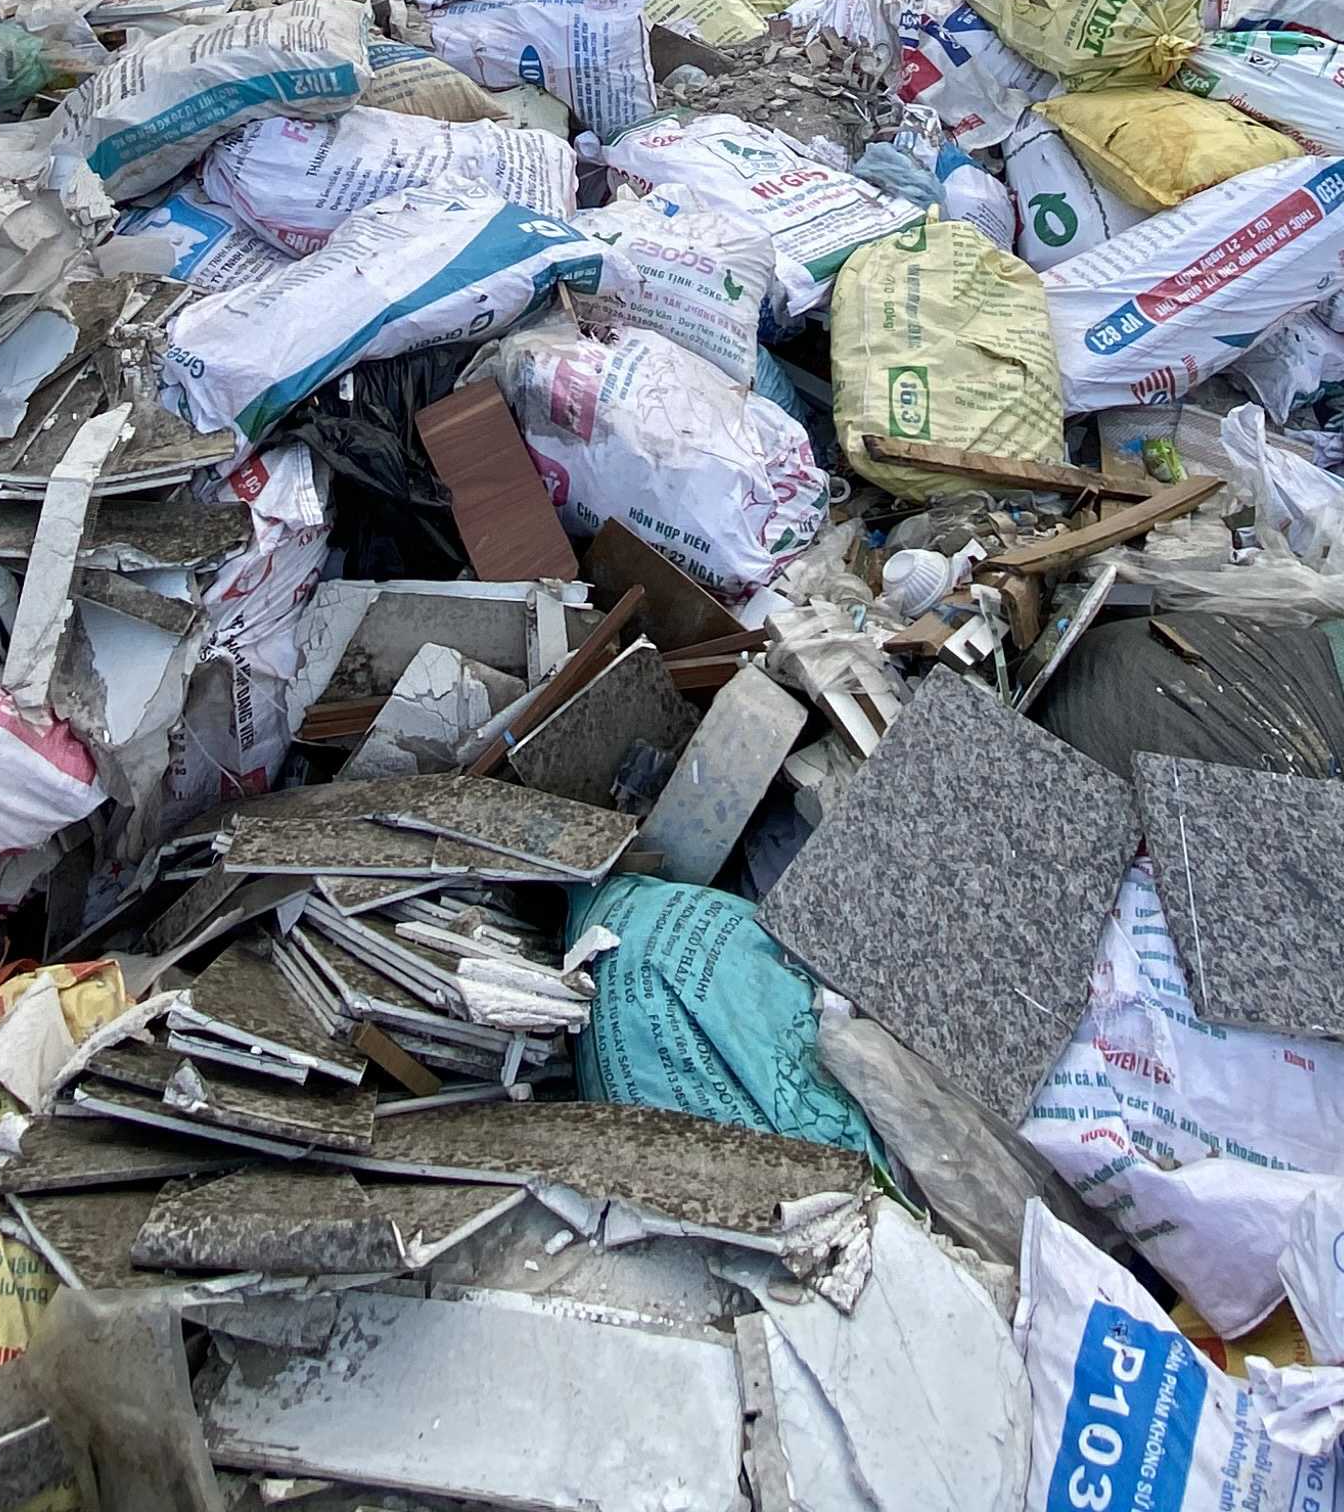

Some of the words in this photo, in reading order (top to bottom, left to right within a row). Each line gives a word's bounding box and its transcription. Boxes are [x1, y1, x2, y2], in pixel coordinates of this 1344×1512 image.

[1089, 322, 1123, 356] 821
[1114, 307, 1145, 339] VP
[654, 520, 681, 542] HỢP
[681, 530, 712, 554] VIÊN
[607, 1020, 627, 1054] NGÀY
[646, 1013, 667, 1045] FAX:
[1153, 1372, 1182, 1418] PHẨM
[1065, 1335, 1147, 1512] P103
[1139, 1418, 1171, 1479] KHÔNG
